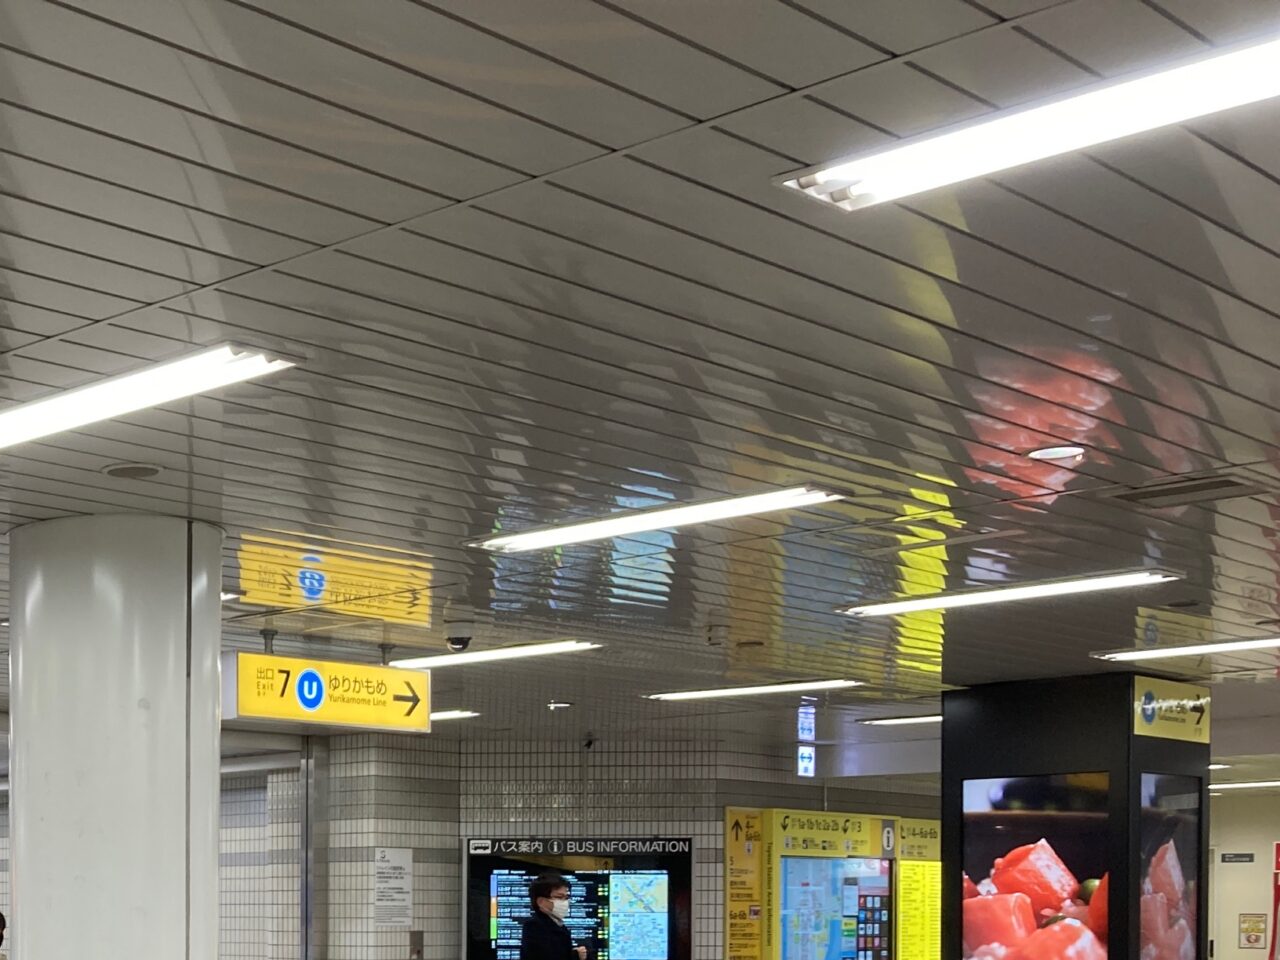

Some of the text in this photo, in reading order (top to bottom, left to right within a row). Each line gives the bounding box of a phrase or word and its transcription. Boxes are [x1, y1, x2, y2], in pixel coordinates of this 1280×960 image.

[256, 667, 274, 680] 出口
[256, 681, 274, 691] Exit
[277, 669, 291, 698] 7
[303, 680, 318, 700] U
[328, 674, 388, 696] ゆりかもめ
[328, 693, 387, 707] Yurikamome Line
[494, 841, 543, 853] バス案内
[567, 841, 689, 853] BUS INFORMATION
